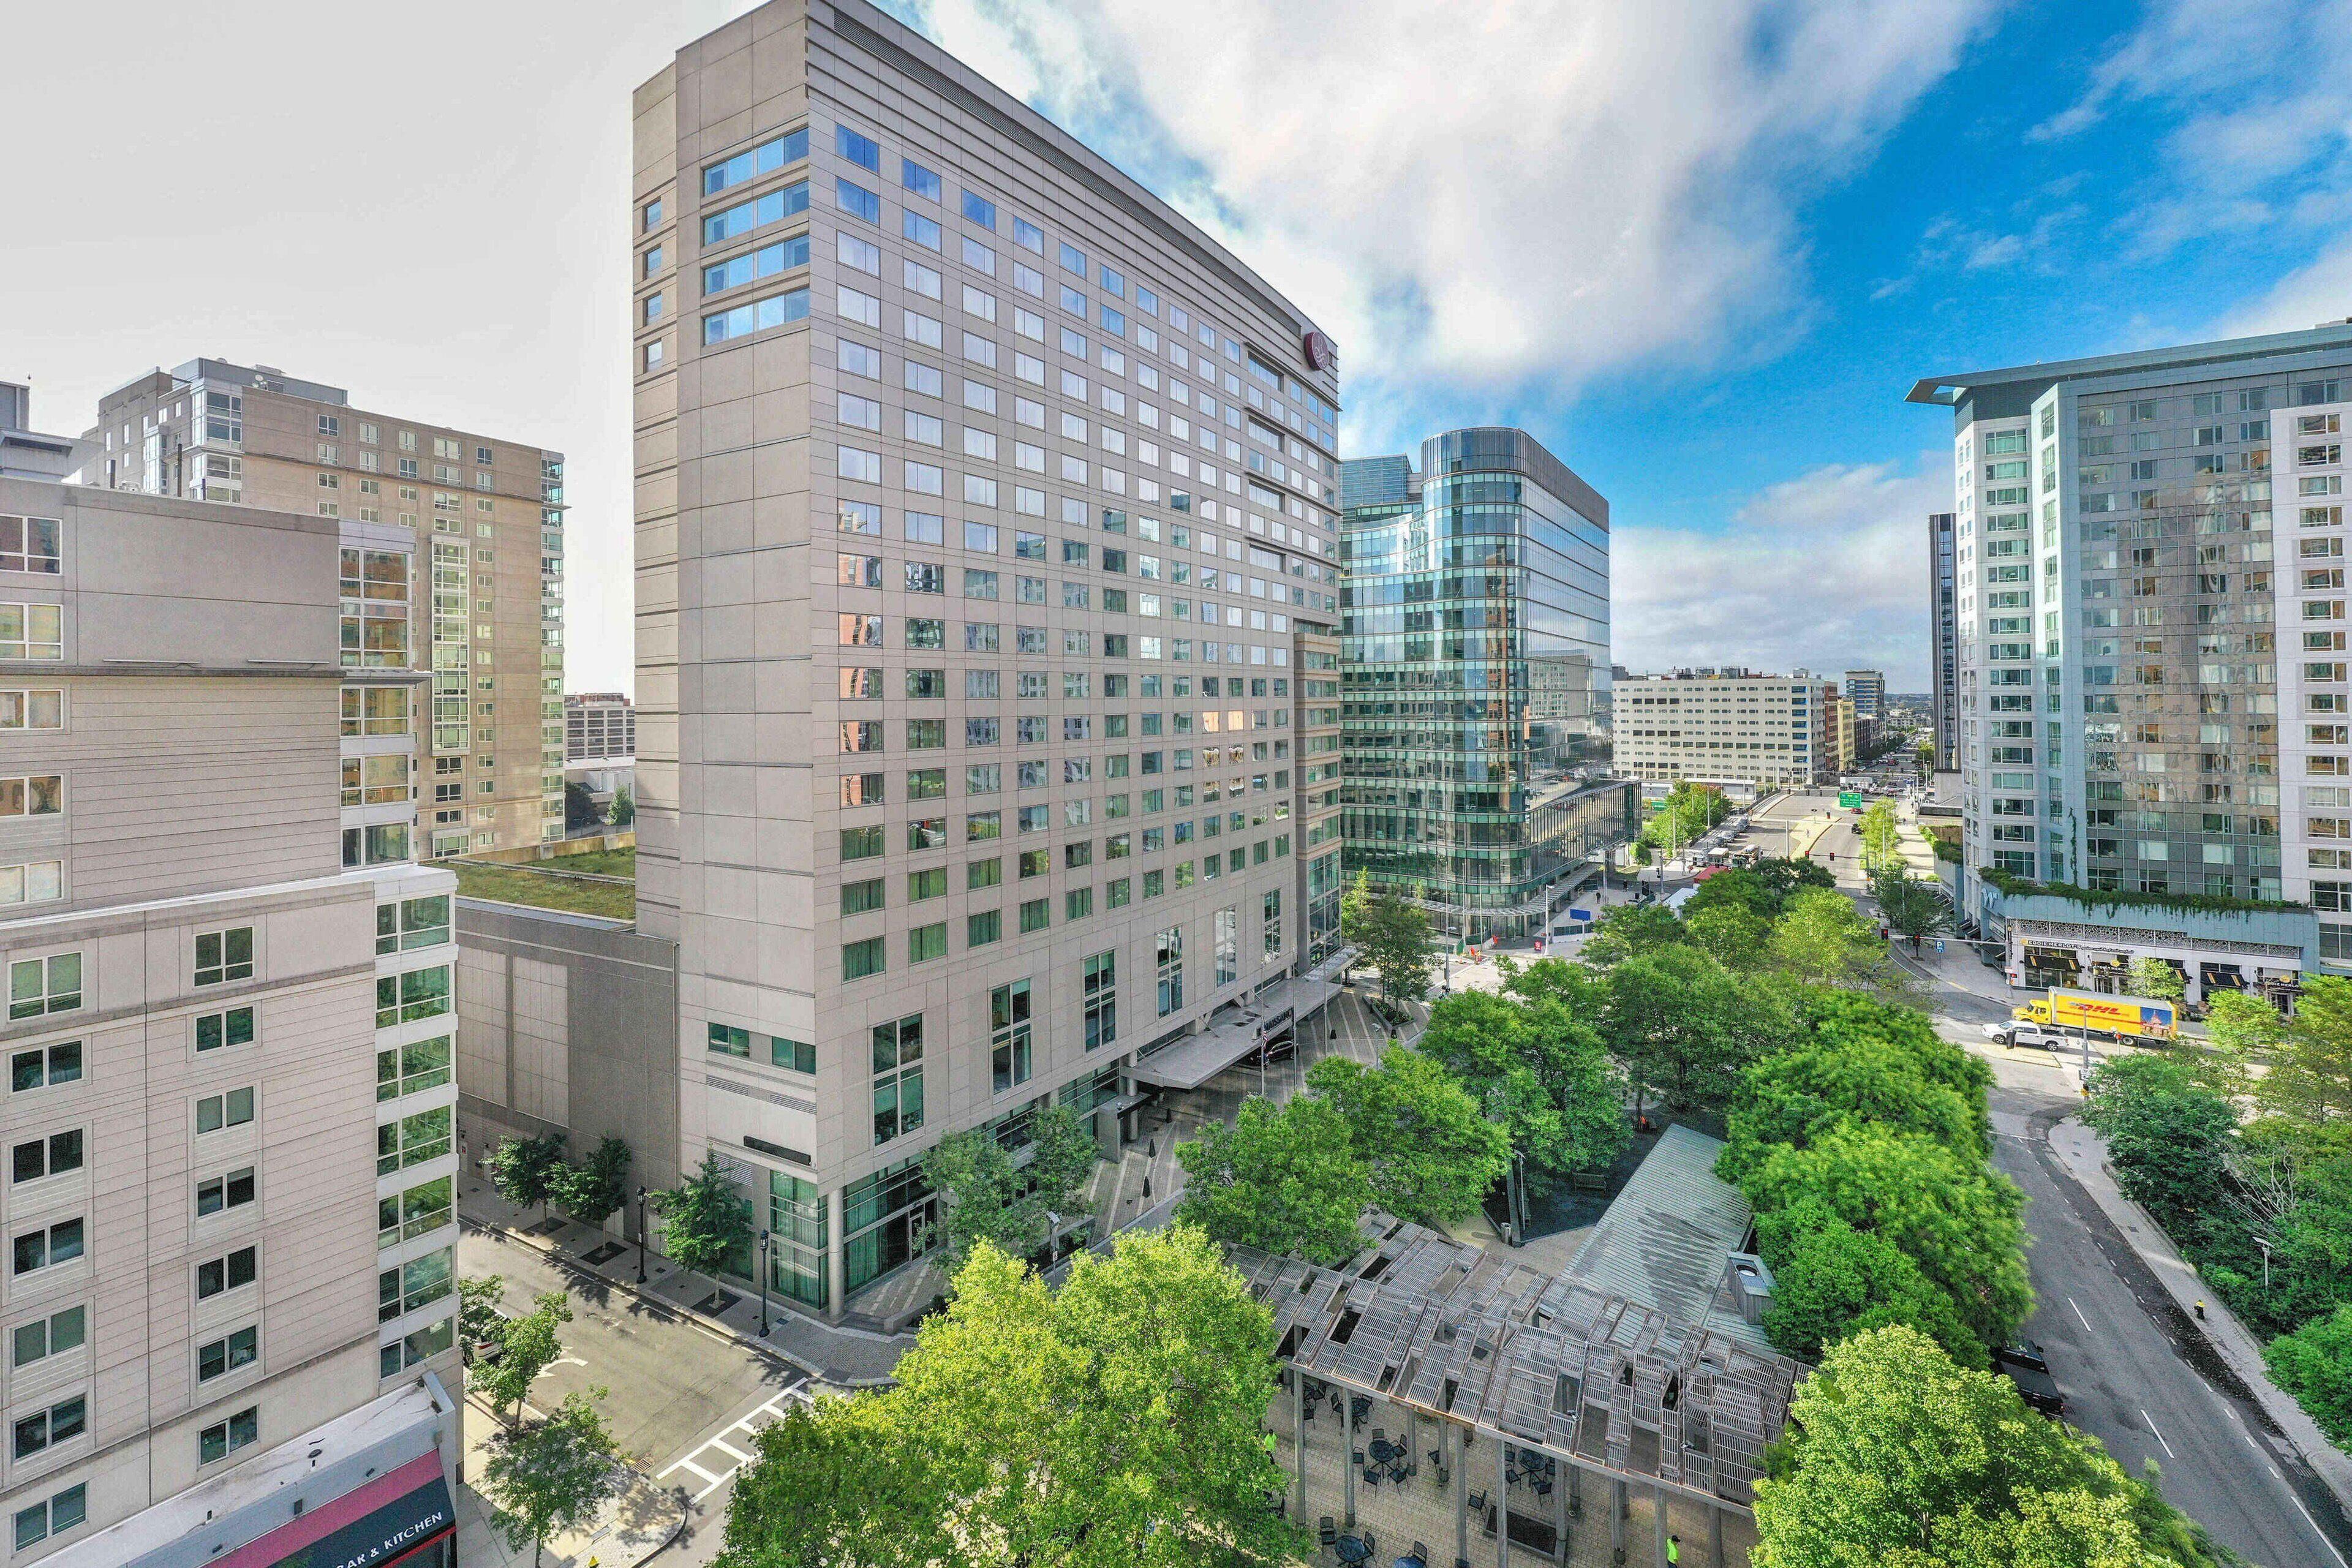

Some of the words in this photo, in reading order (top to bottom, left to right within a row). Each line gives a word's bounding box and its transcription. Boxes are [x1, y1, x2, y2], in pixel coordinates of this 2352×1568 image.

[2078, 1004, 2120, 1015] DHL
[371, 1548, 379, 1558] &
[384, 1512, 442, 1550] KITCHEN
